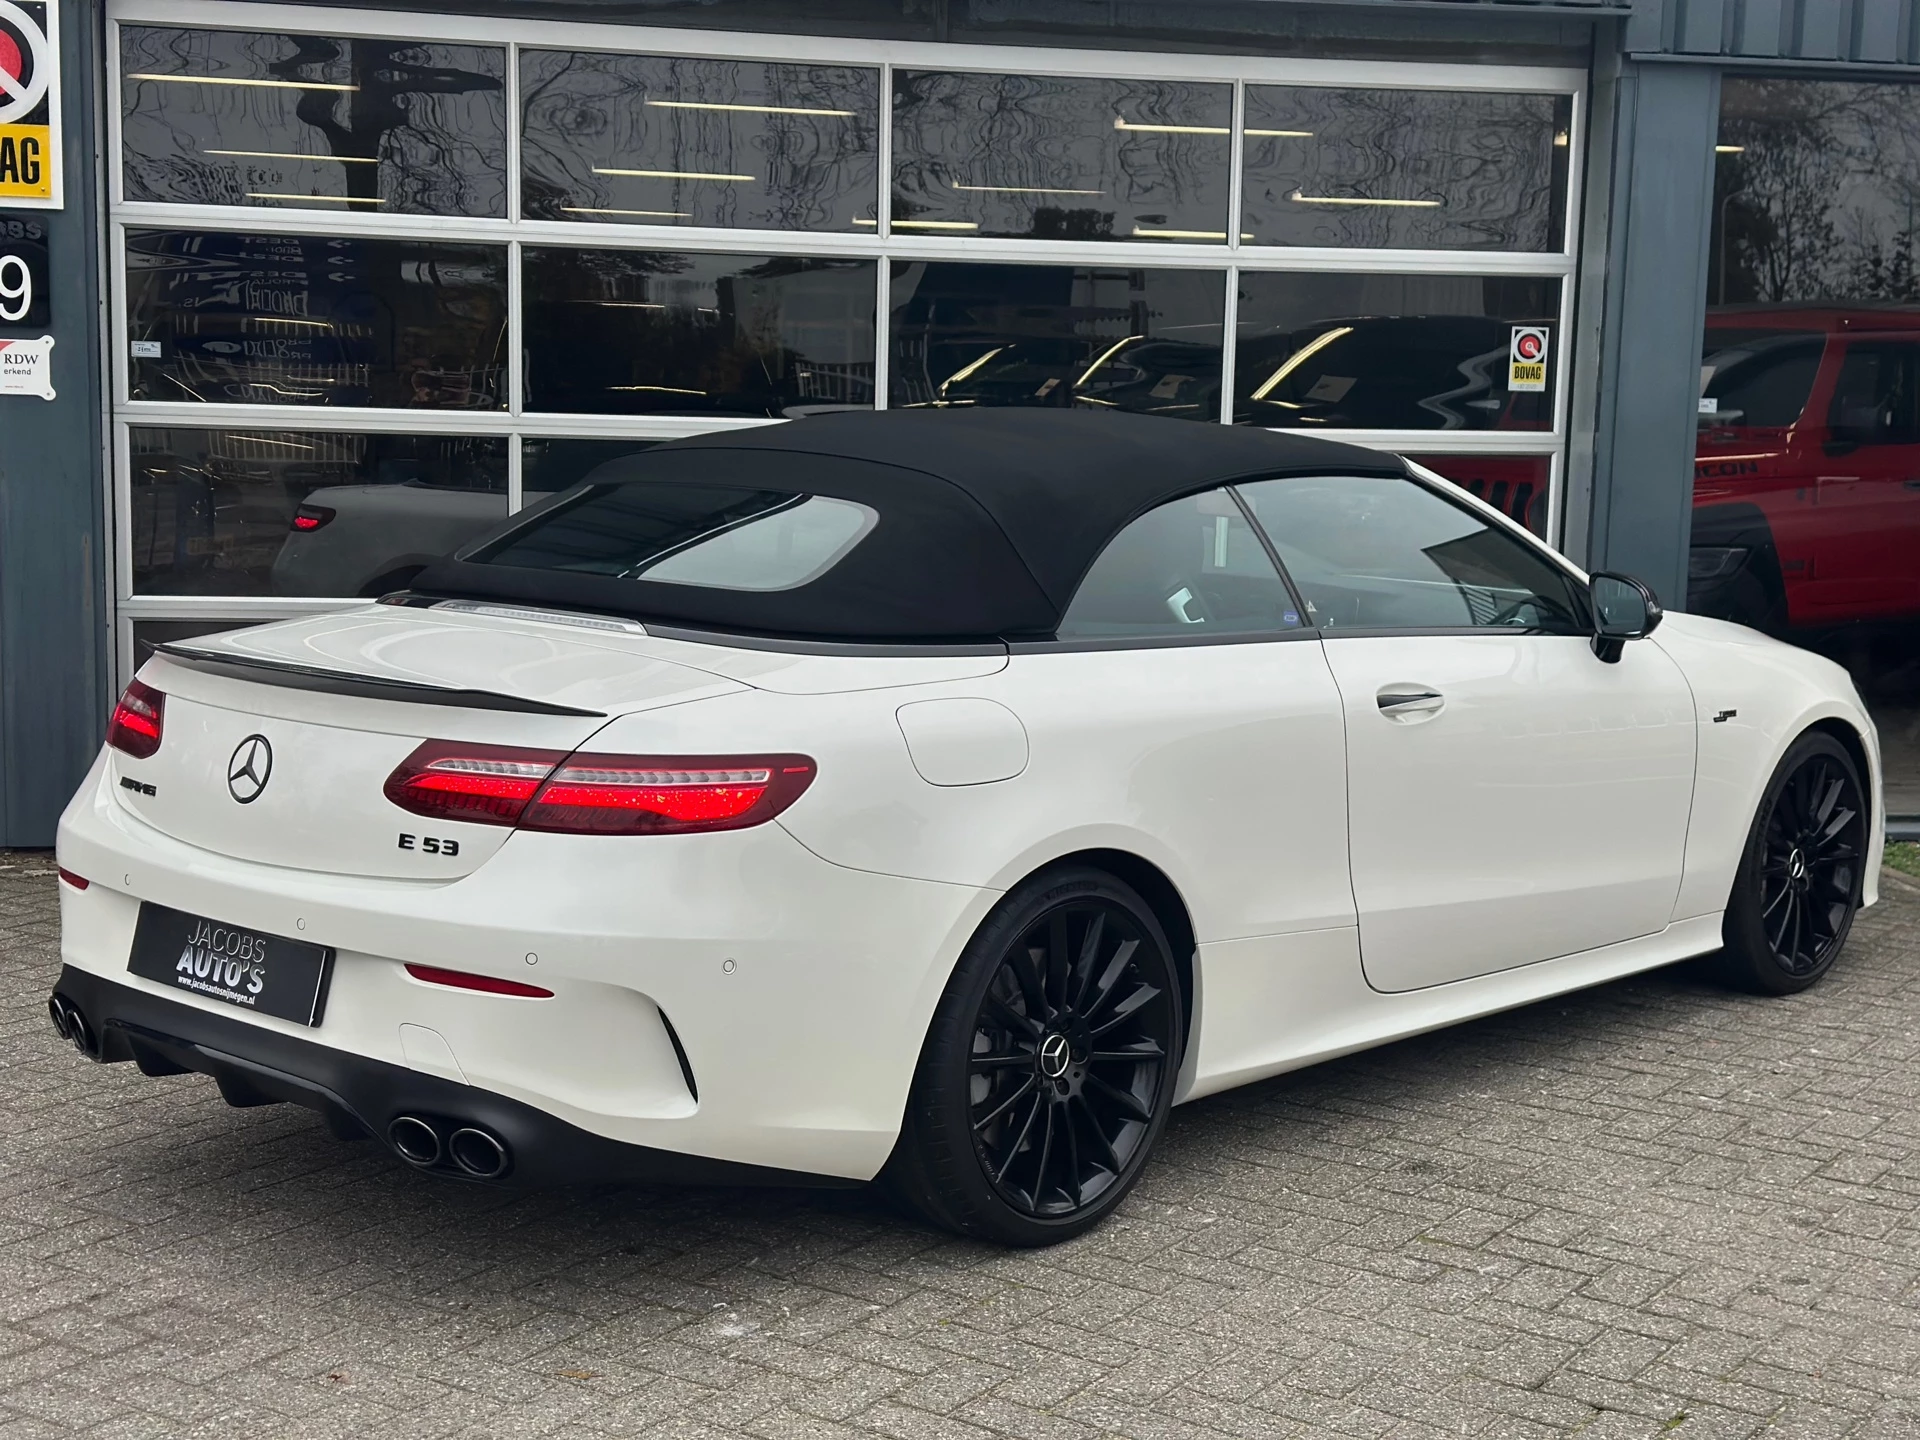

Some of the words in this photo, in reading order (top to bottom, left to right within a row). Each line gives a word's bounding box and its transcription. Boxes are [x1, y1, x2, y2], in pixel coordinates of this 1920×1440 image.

[0, 254, 32, 321] 9
[3, 367, 32, 375] erkend
[4, 353, 39, 365] RDW
[1514, 365, 1542, 380] BOVAG
[398, 832, 416, 851] E
[422, 836, 460, 857] 53
[187, 920, 266, 963] JACOBS
[176, 944, 266, 994] AUTO'S
[177, 975, 257, 1006] www.jacobsautosnijmegen.nl
